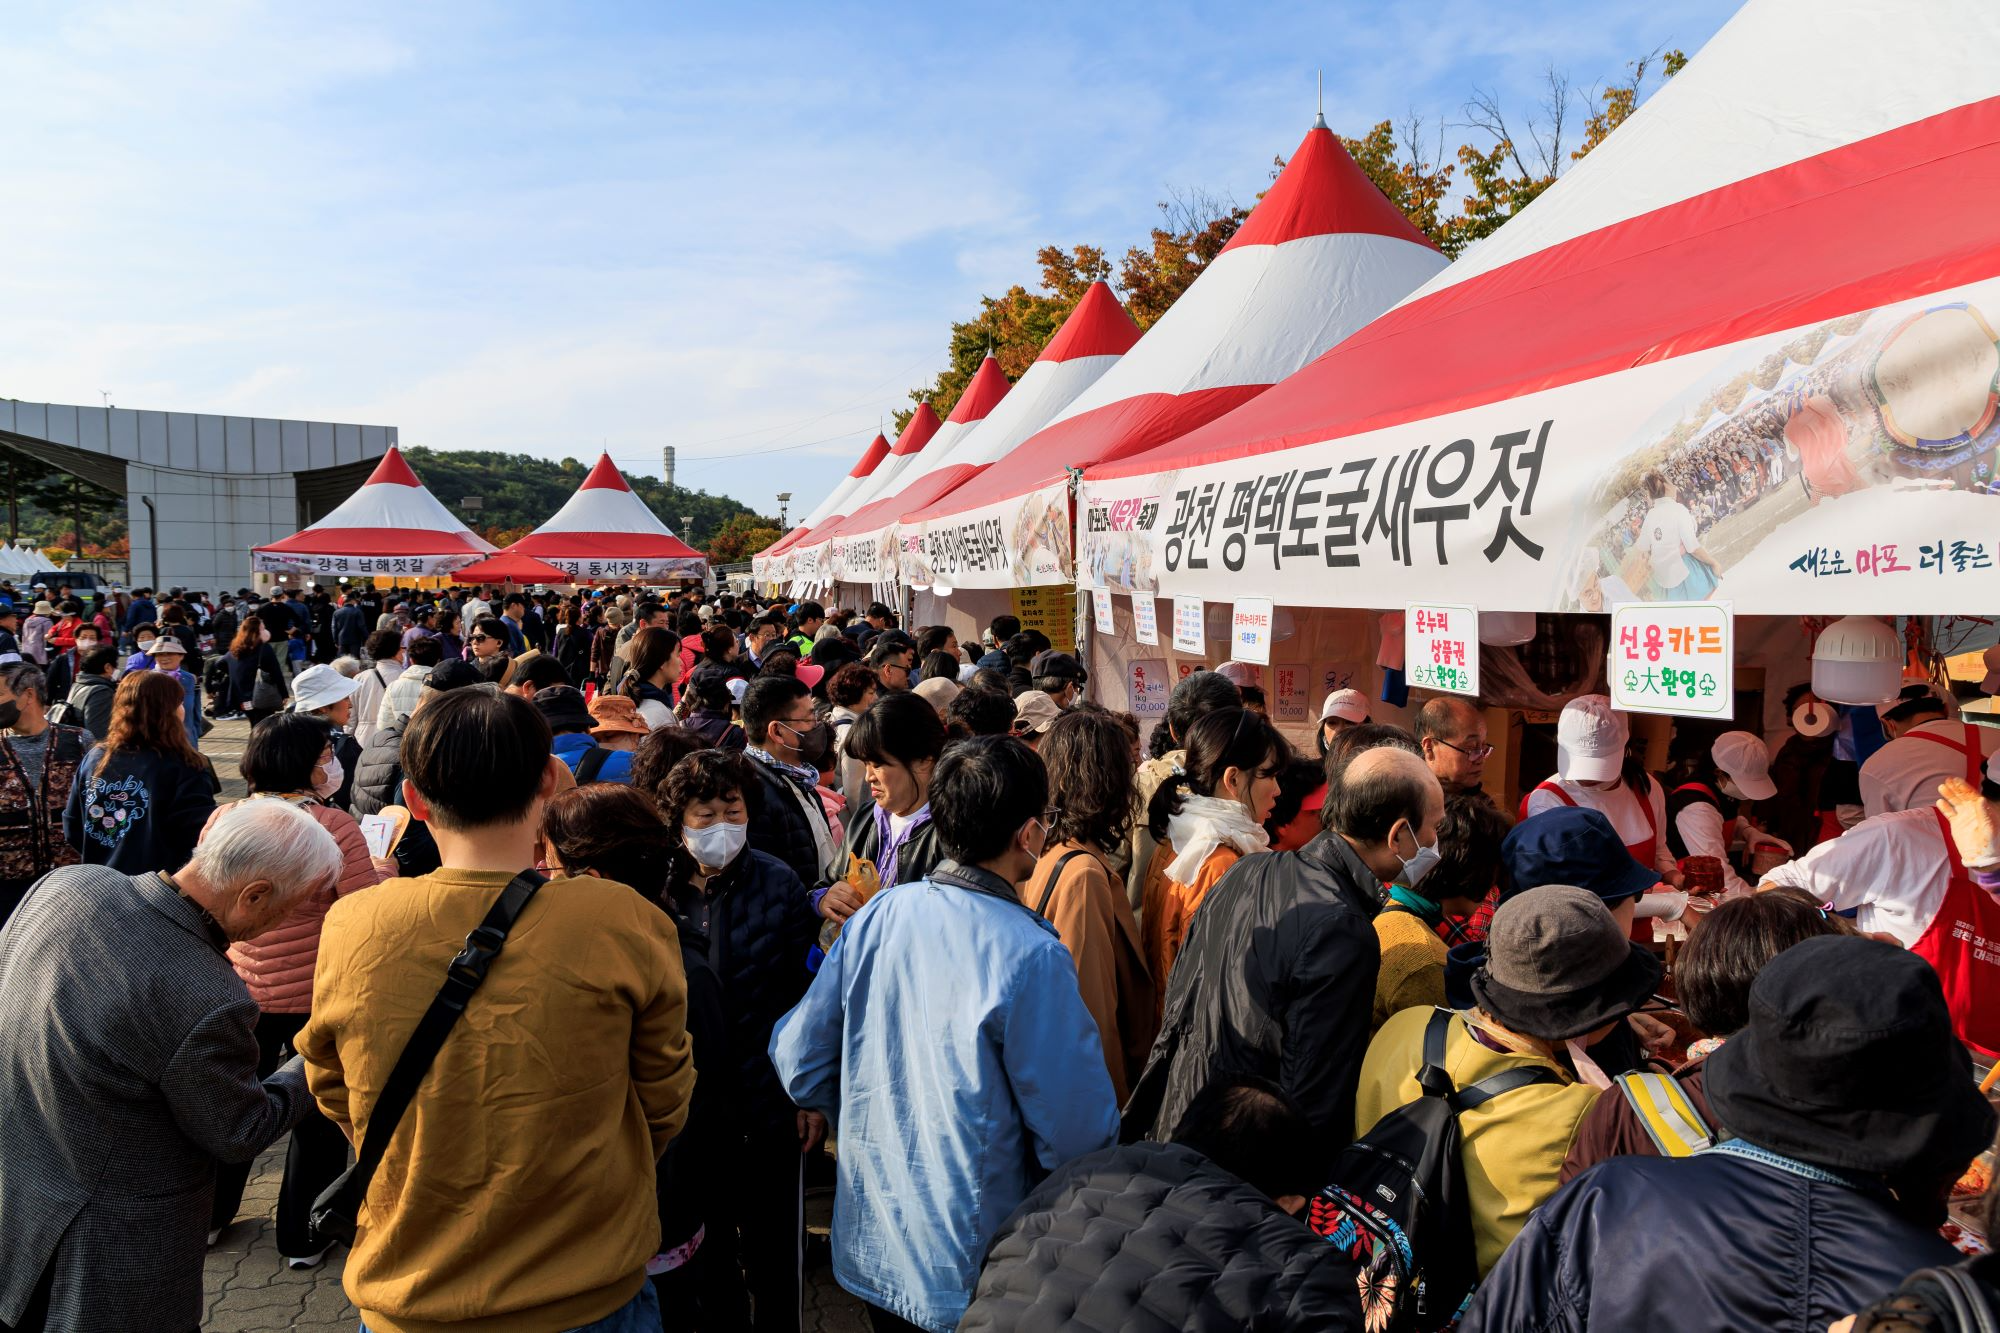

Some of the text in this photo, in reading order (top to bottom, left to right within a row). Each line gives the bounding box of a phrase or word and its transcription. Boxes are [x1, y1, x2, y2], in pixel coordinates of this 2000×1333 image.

[1164, 418, 1554, 573] 광천 평택토굴새우젓
[317, 557, 349, 572] 강경
[358, 557, 424, 573] 남해젓갈
[928, 530, 946, 575] 광천
[1788, 547, 1853, 578] 새로운
[1855, 543, 1912, 577] 마포
[1918, 540, 1944, 575] 더
[1947, 539, 1993, 573] 좋은
[588, 561, 650, 576] 동서젓갈
[1415, 609, 1448, 634] 온누리
[1431, 638, 1465, 667] 상품권
[1619, 623, 1723, 662] 신용카드
[1135, 702, 1166, 713] 50,000
[1279, 707, 1303, 717] 10,000
